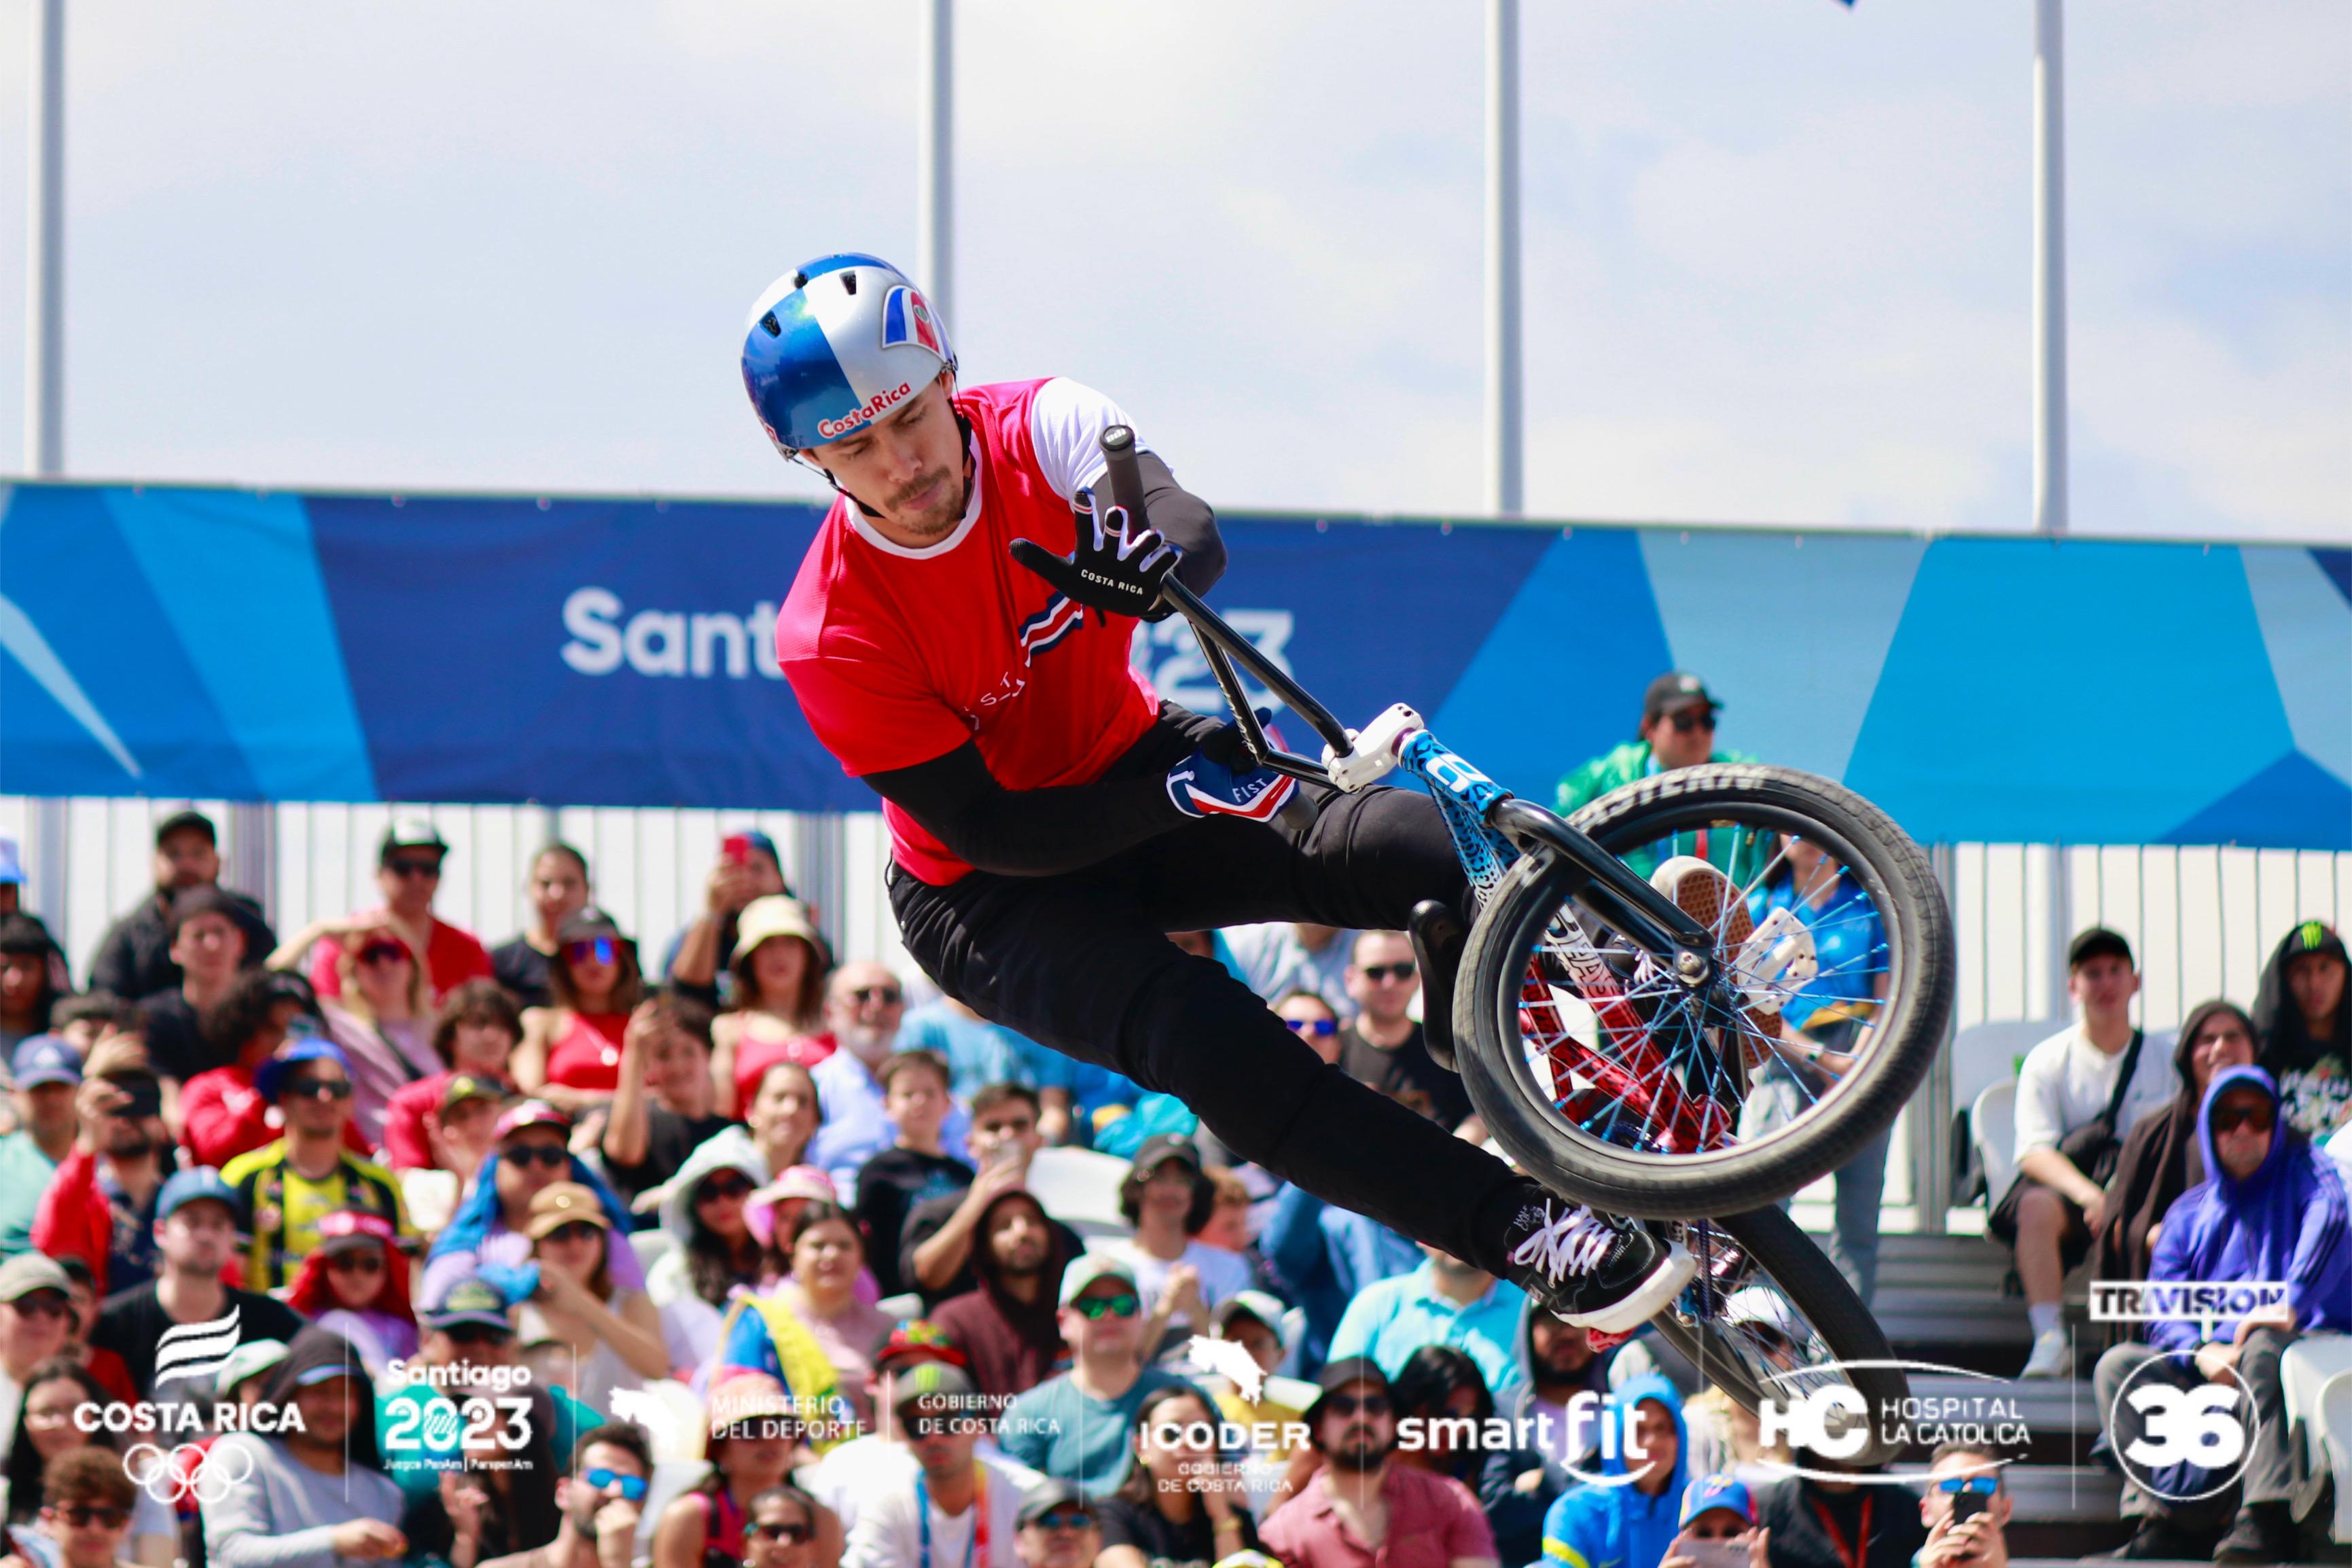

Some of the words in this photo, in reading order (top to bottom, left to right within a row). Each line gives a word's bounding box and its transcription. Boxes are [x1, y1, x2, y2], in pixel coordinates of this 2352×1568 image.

[818, 381, 911, 438] CostaRica
[1081, 569, 1114, 587] COSTA
[1118, 581, 1144, 596] RICA
[560, 586, 788, 679] Sant
[1130, 607, 1296, 720] 23
[1232, 778, 1267, 802] FIST
